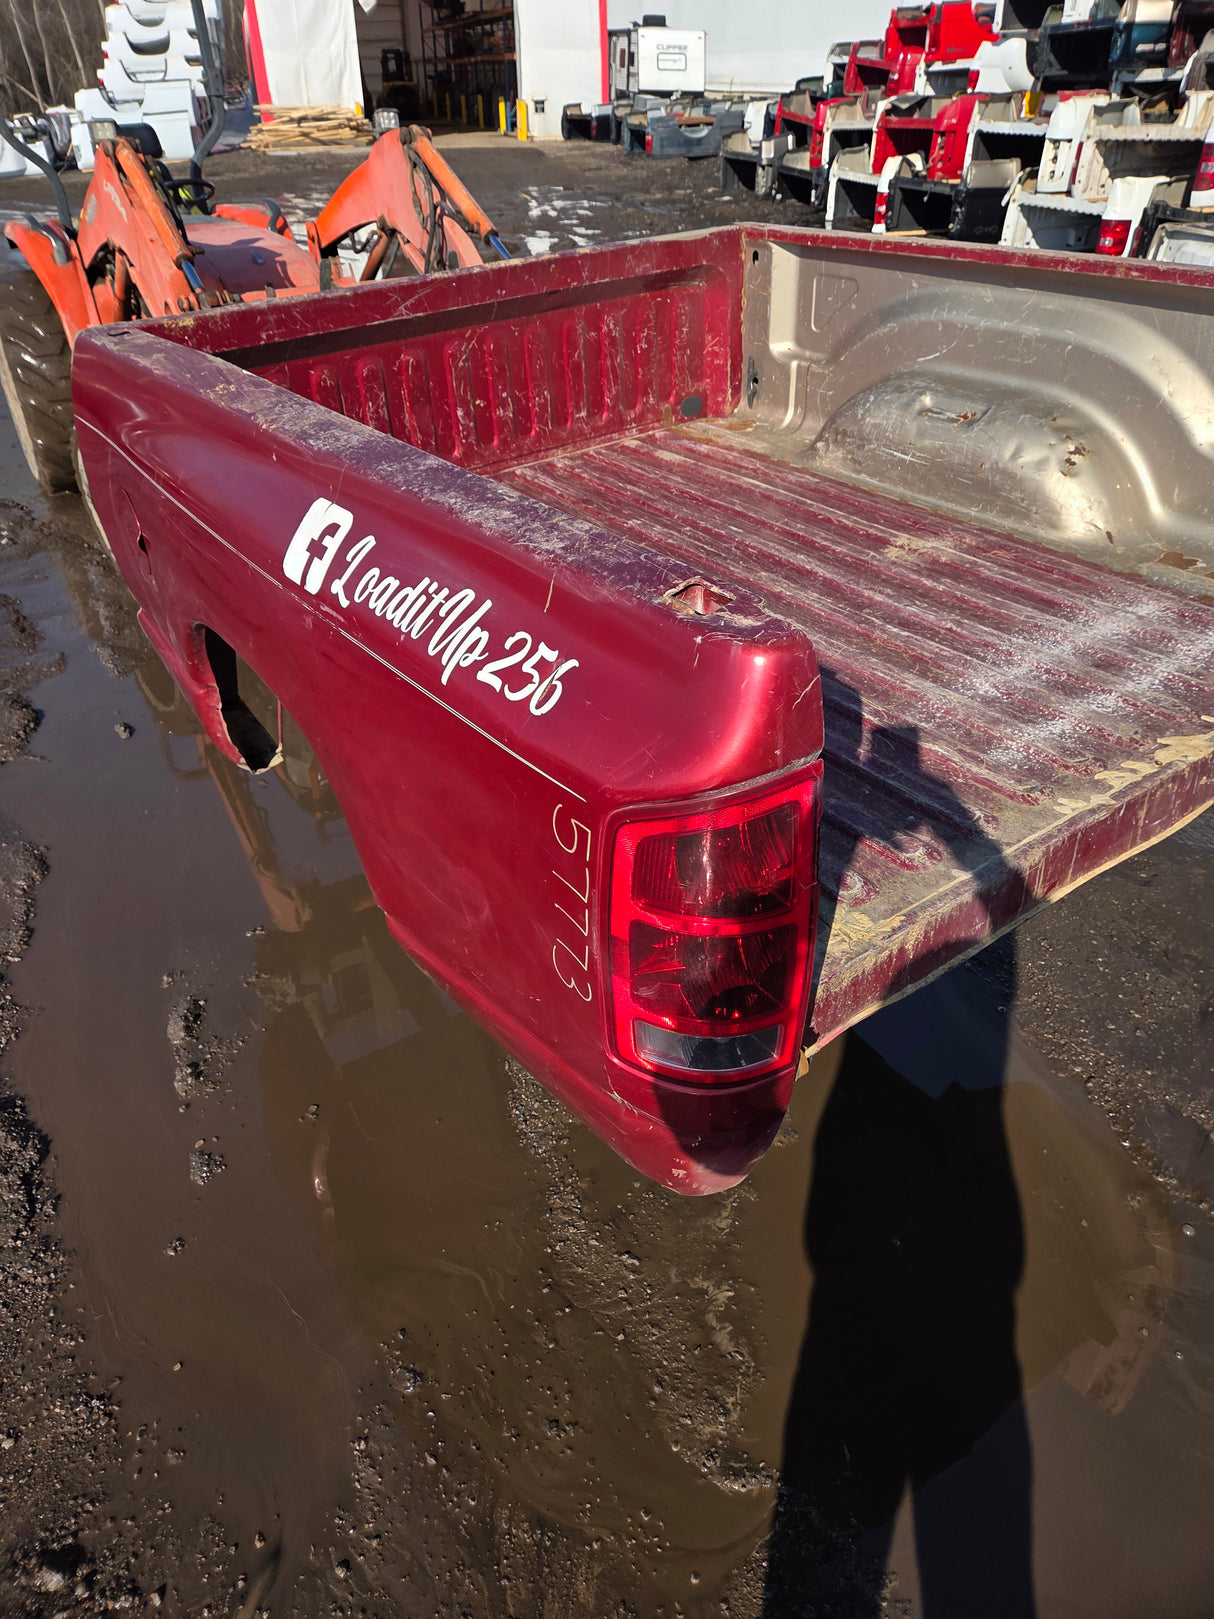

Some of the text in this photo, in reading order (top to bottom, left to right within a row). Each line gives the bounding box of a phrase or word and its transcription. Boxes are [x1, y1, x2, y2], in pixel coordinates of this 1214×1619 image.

[656, 43, 688, 51] CLIPPER
[476, 631, 580, 716] 256
[552, 803, 592, 1002] 57773
